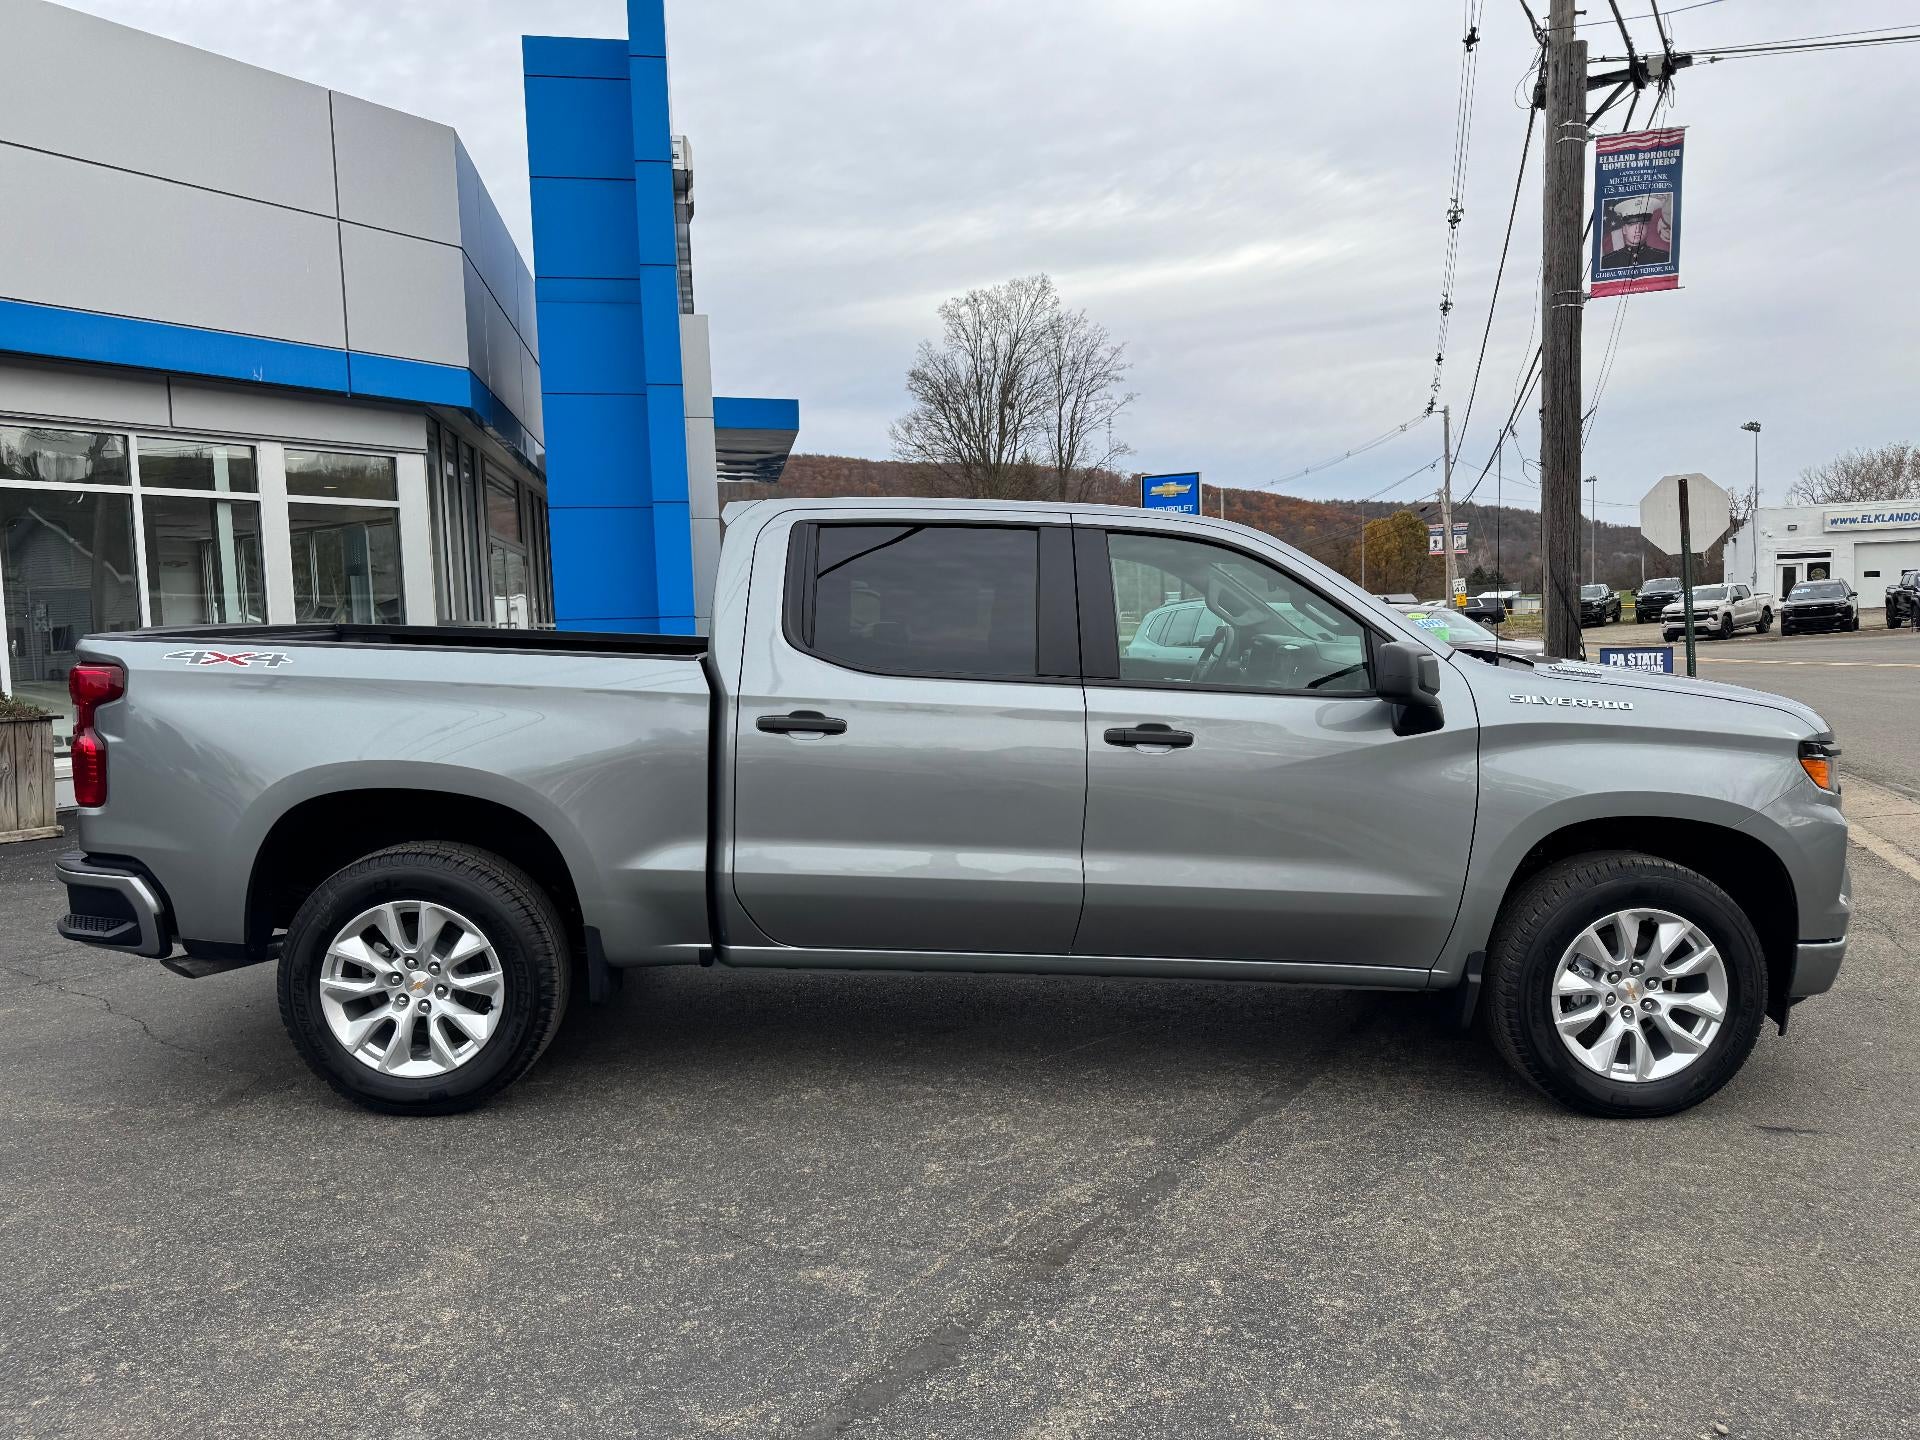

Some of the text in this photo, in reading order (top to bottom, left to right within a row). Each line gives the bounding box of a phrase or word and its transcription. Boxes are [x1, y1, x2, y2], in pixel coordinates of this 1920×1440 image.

[1599, 149, 1680, 163] ELKLAND BOROUGH
[1602, 158, 1676, 170] HOMETOWN HERO
[1618, 184, 1647, 192] MARINE
[1830, 512, 1920, 525] www.ELKLANDC
[1610, 652, 1664, 666] PA STATE
[1509, 694, 1634, 710] SILVERADO
